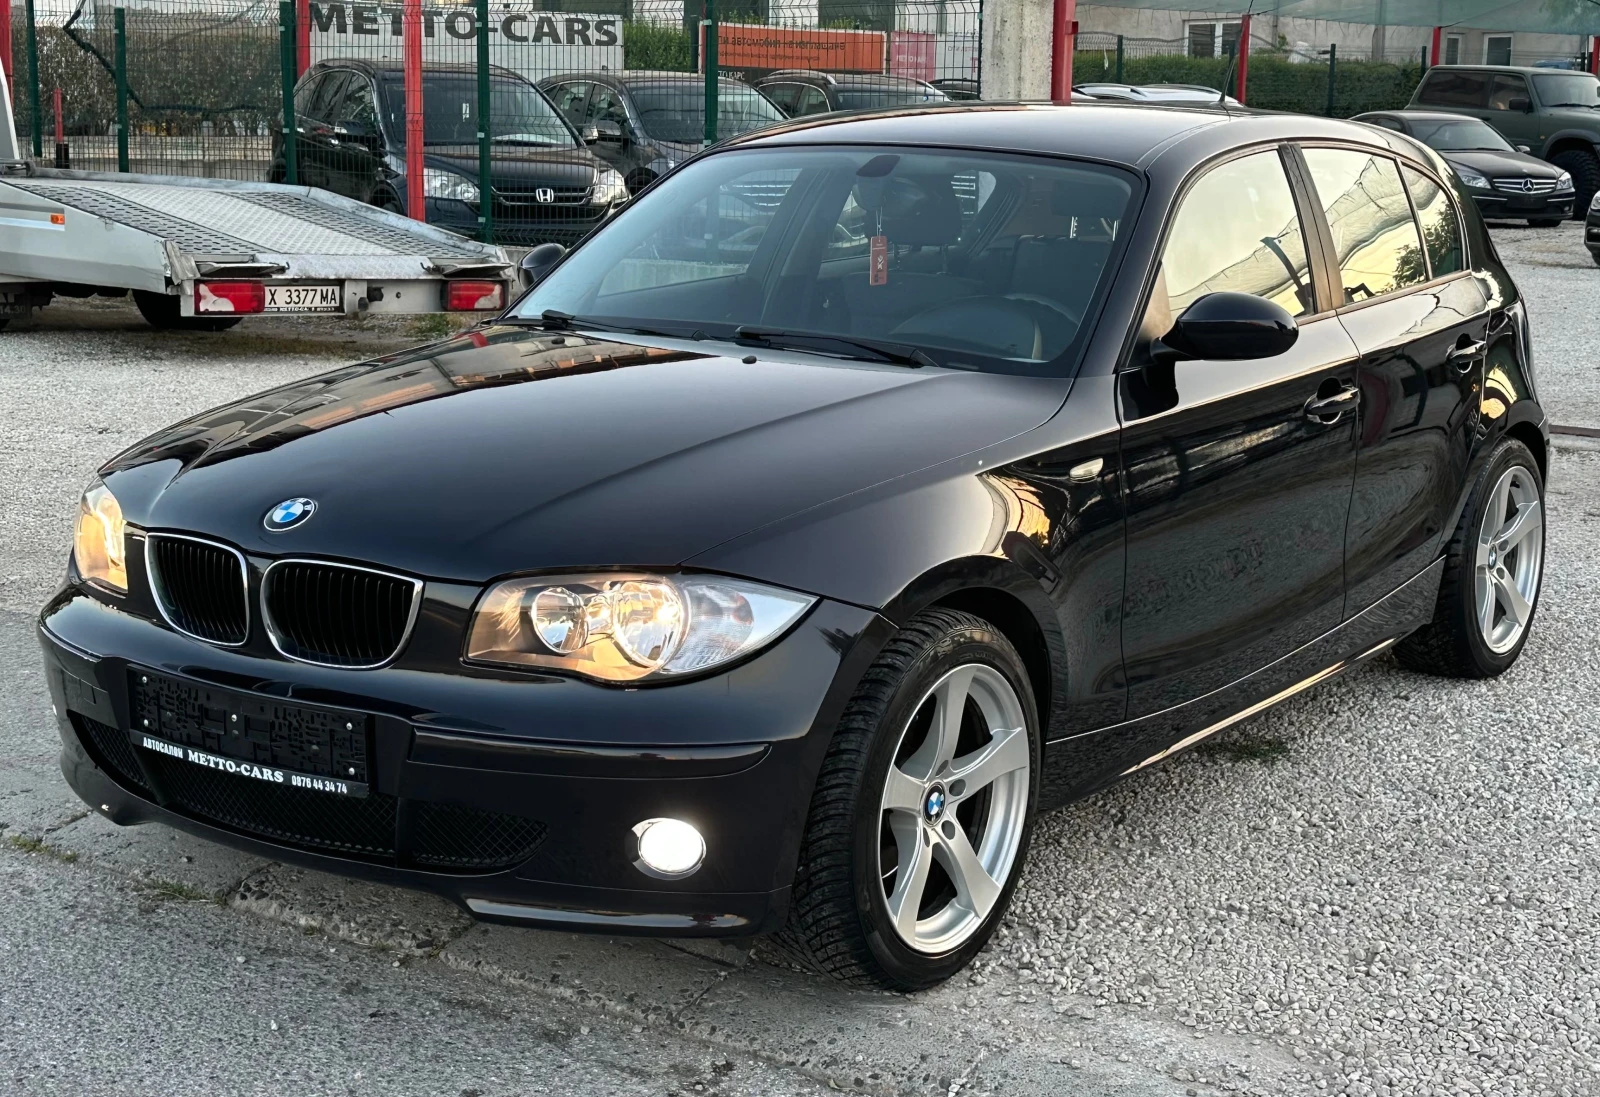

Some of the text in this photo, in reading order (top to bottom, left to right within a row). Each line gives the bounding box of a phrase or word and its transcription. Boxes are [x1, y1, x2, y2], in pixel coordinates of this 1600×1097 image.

[309, 3, 617, 46] METTO-CARS
[284, 288, 317, 305] 3377
[320, 288, 337, 305] MA
[143, 736, 184, 759] АВТОСАЛОН
[187, 749, 284, 783] METTO-CARS
[313, 778, 323, 791] 44
[325, 780, 335, 793] 34
[336, 782, 348, 794] 74
